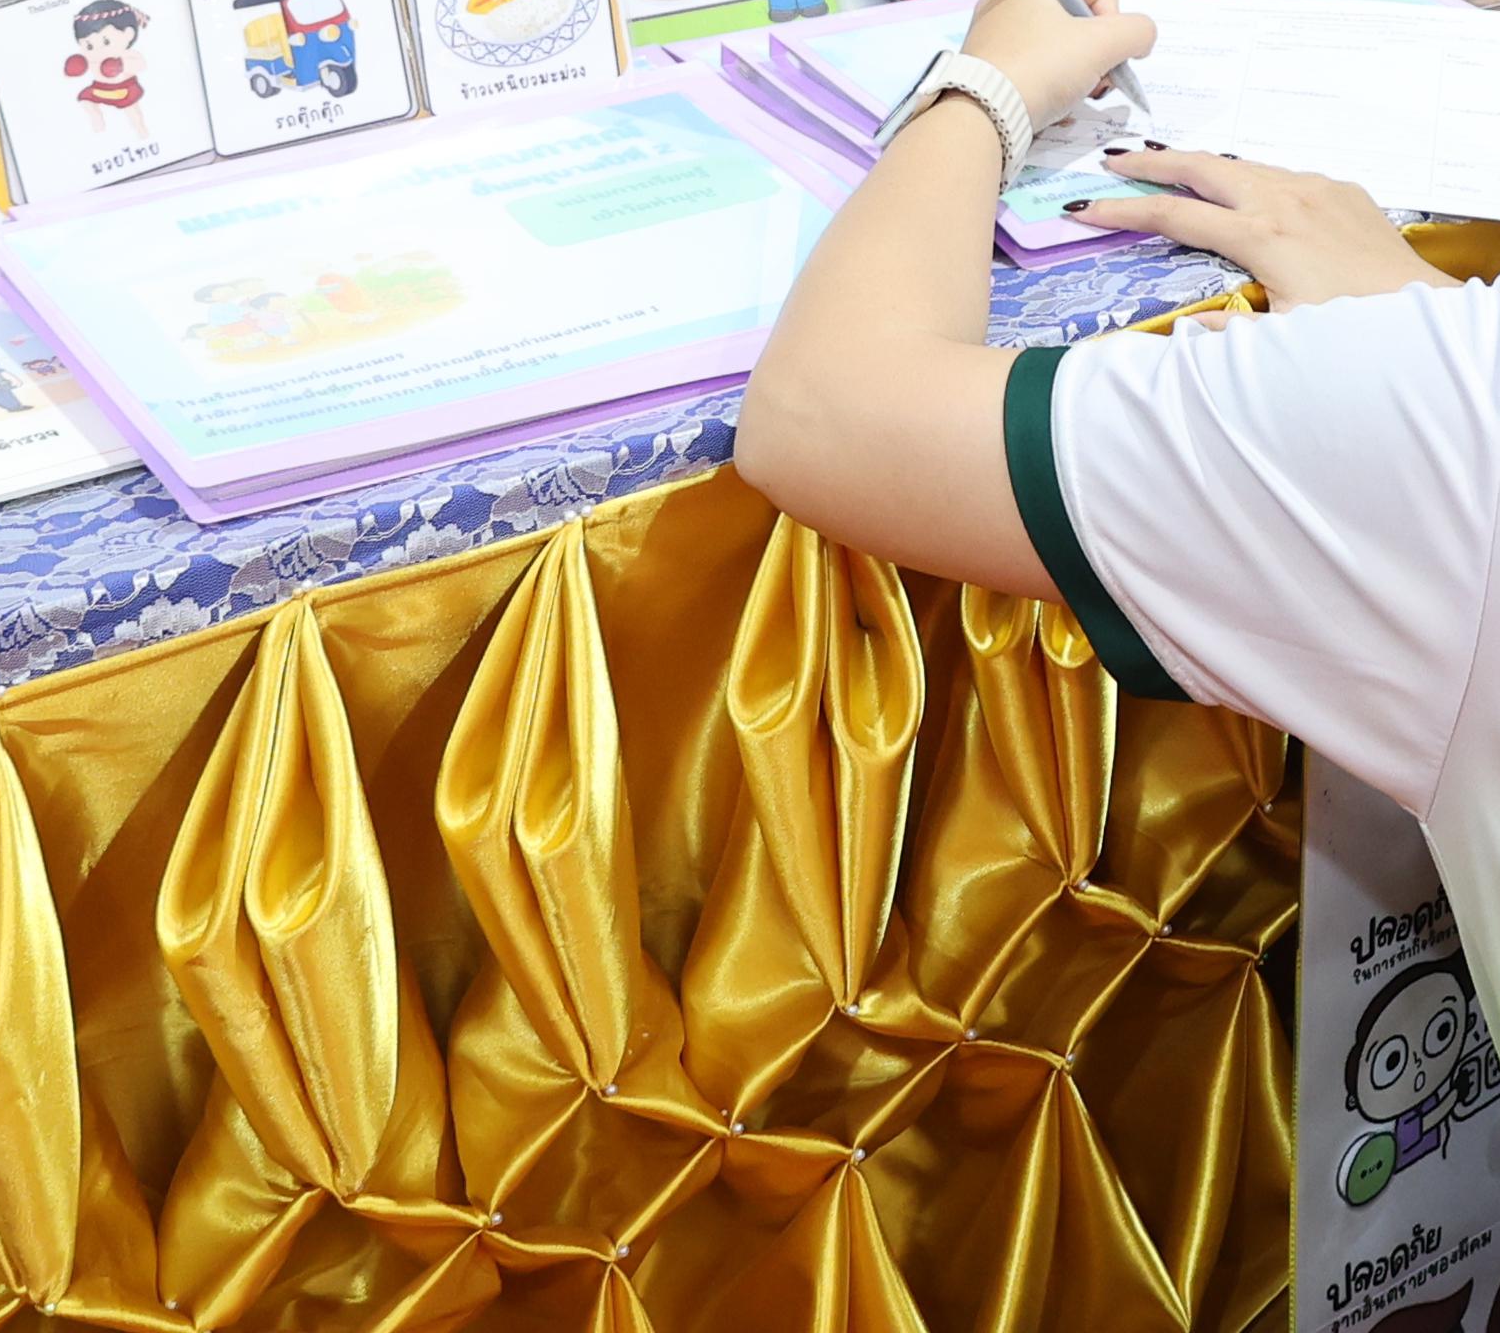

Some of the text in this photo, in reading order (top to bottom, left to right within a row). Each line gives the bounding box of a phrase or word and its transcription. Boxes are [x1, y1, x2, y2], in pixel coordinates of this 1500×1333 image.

[460, 64, 587, 102] ข้าวเหนียวมะม่วง
[91, 141, 161, 175] มวยไทย
[1326, 1223, 1444, 1314] ปลอดภัย
